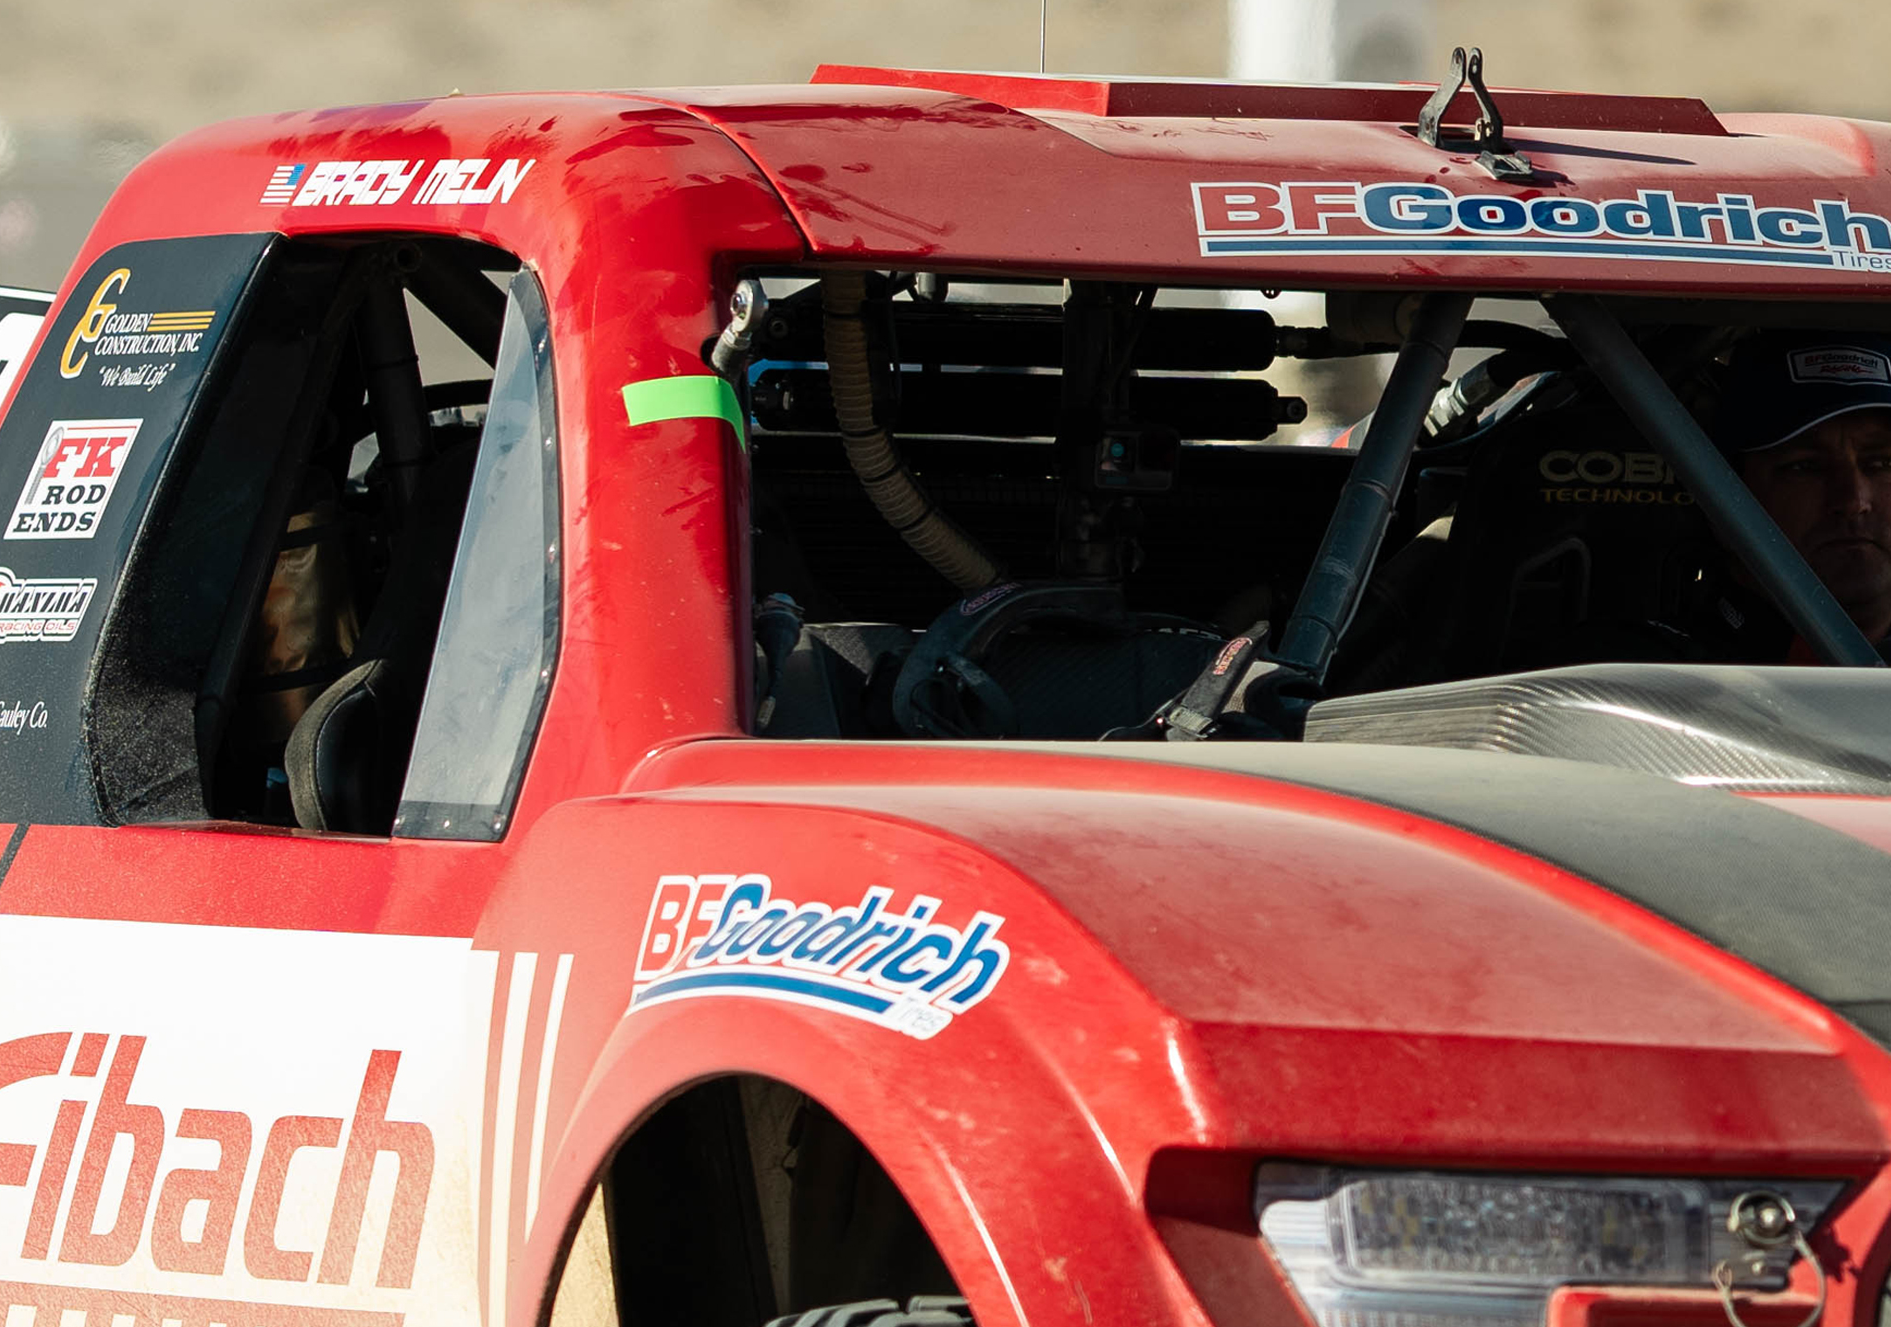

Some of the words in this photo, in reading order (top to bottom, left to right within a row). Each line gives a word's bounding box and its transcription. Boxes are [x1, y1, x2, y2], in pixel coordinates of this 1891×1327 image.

[292, 160, 424, 206] BRADY
[105, 313, 153, 333] GOLDEN
[177, 333, 203, 353] INC.
[41, 436, 128, 479] FK
[1539, 450, 1676, 485] COB
[41, 484, 107, 506] ROD
[1540, 488, 1696, 506] TECHNOLO
[13, 512, 97, 533] ENDS
[30, 701, 47, 728] Co.
[634, 874, 1010, 1014] BFGoodrich
